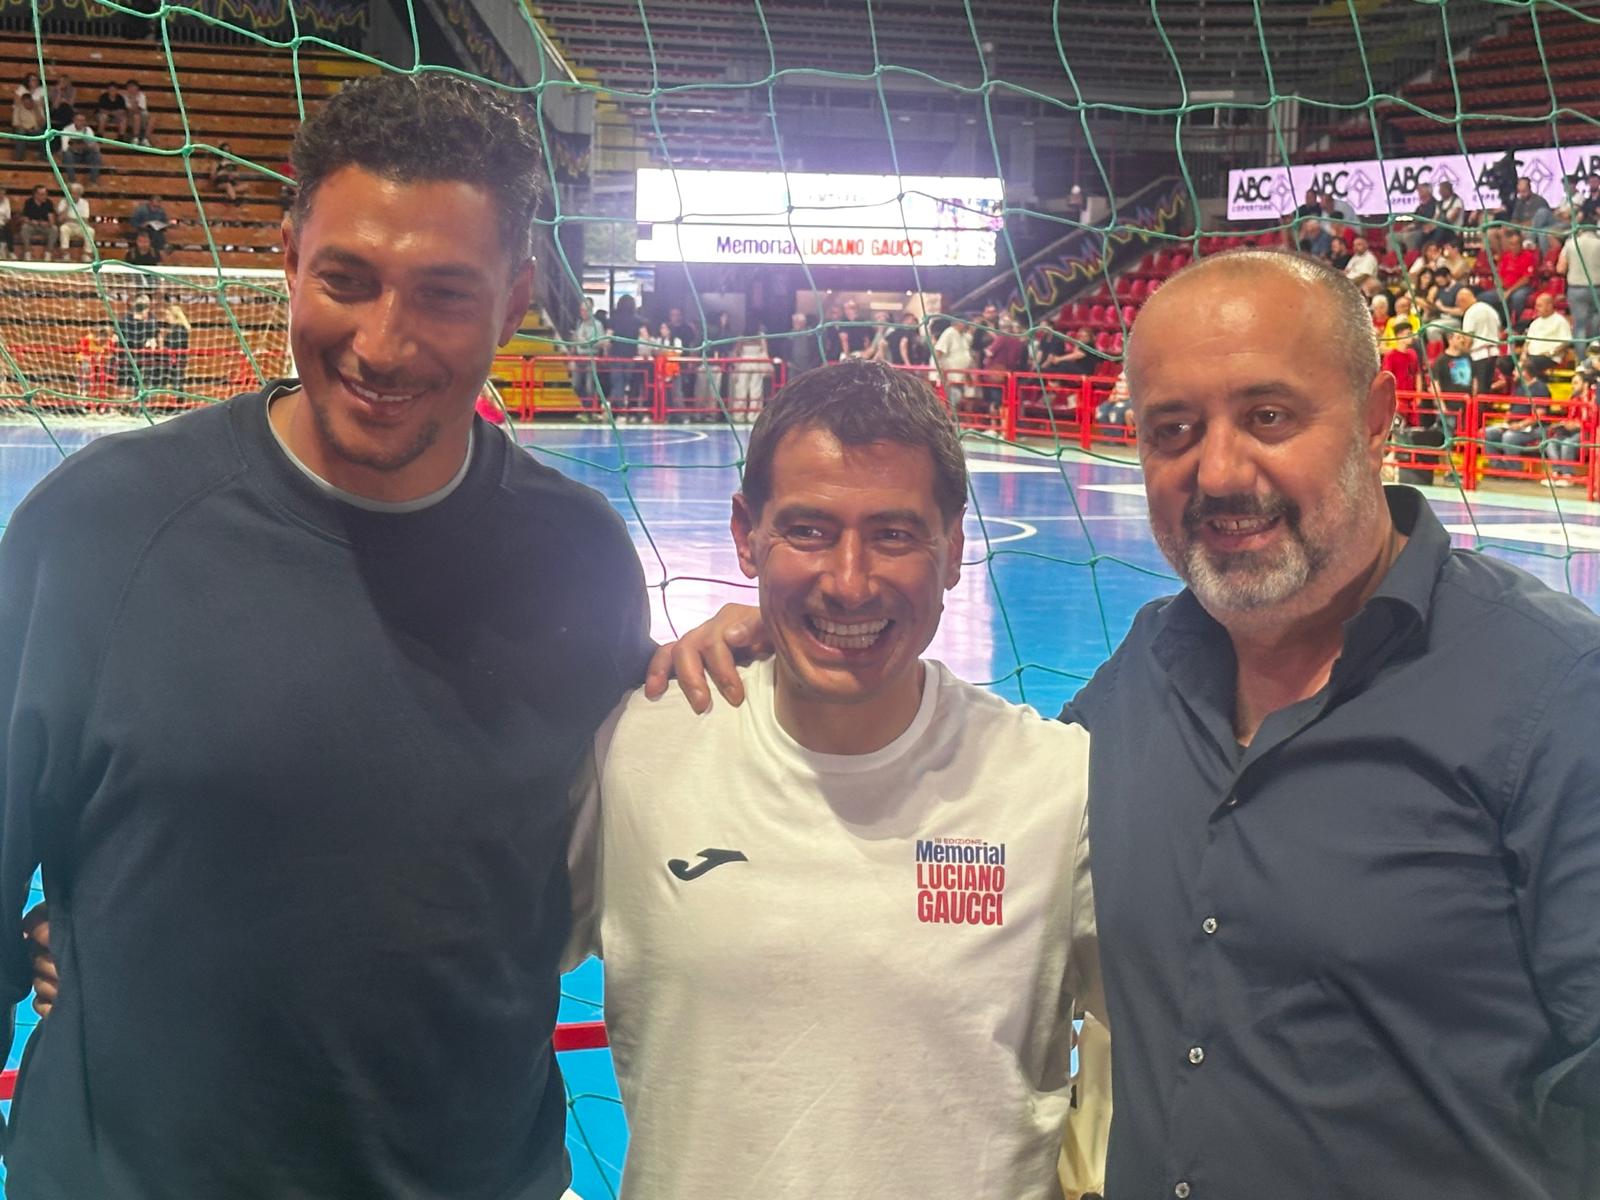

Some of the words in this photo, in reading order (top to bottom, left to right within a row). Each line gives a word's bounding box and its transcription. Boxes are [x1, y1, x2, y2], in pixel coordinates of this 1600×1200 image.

[1233, 175, 1272, 203] ABC
[1309, 170, 1349, 198] ABC
[1388, 165, 1433, 194] ABC
[717, 236, 797, 254] Memorial
[803, 239, 865, 256] LUCIANO
[871, 239, 923, 257] GAUCCI
[915, 839, 1005, 865] Memorial
[916, 863, 1005, 892] LUCIANO
[917, 890, 1003, 926] GAUCCI
